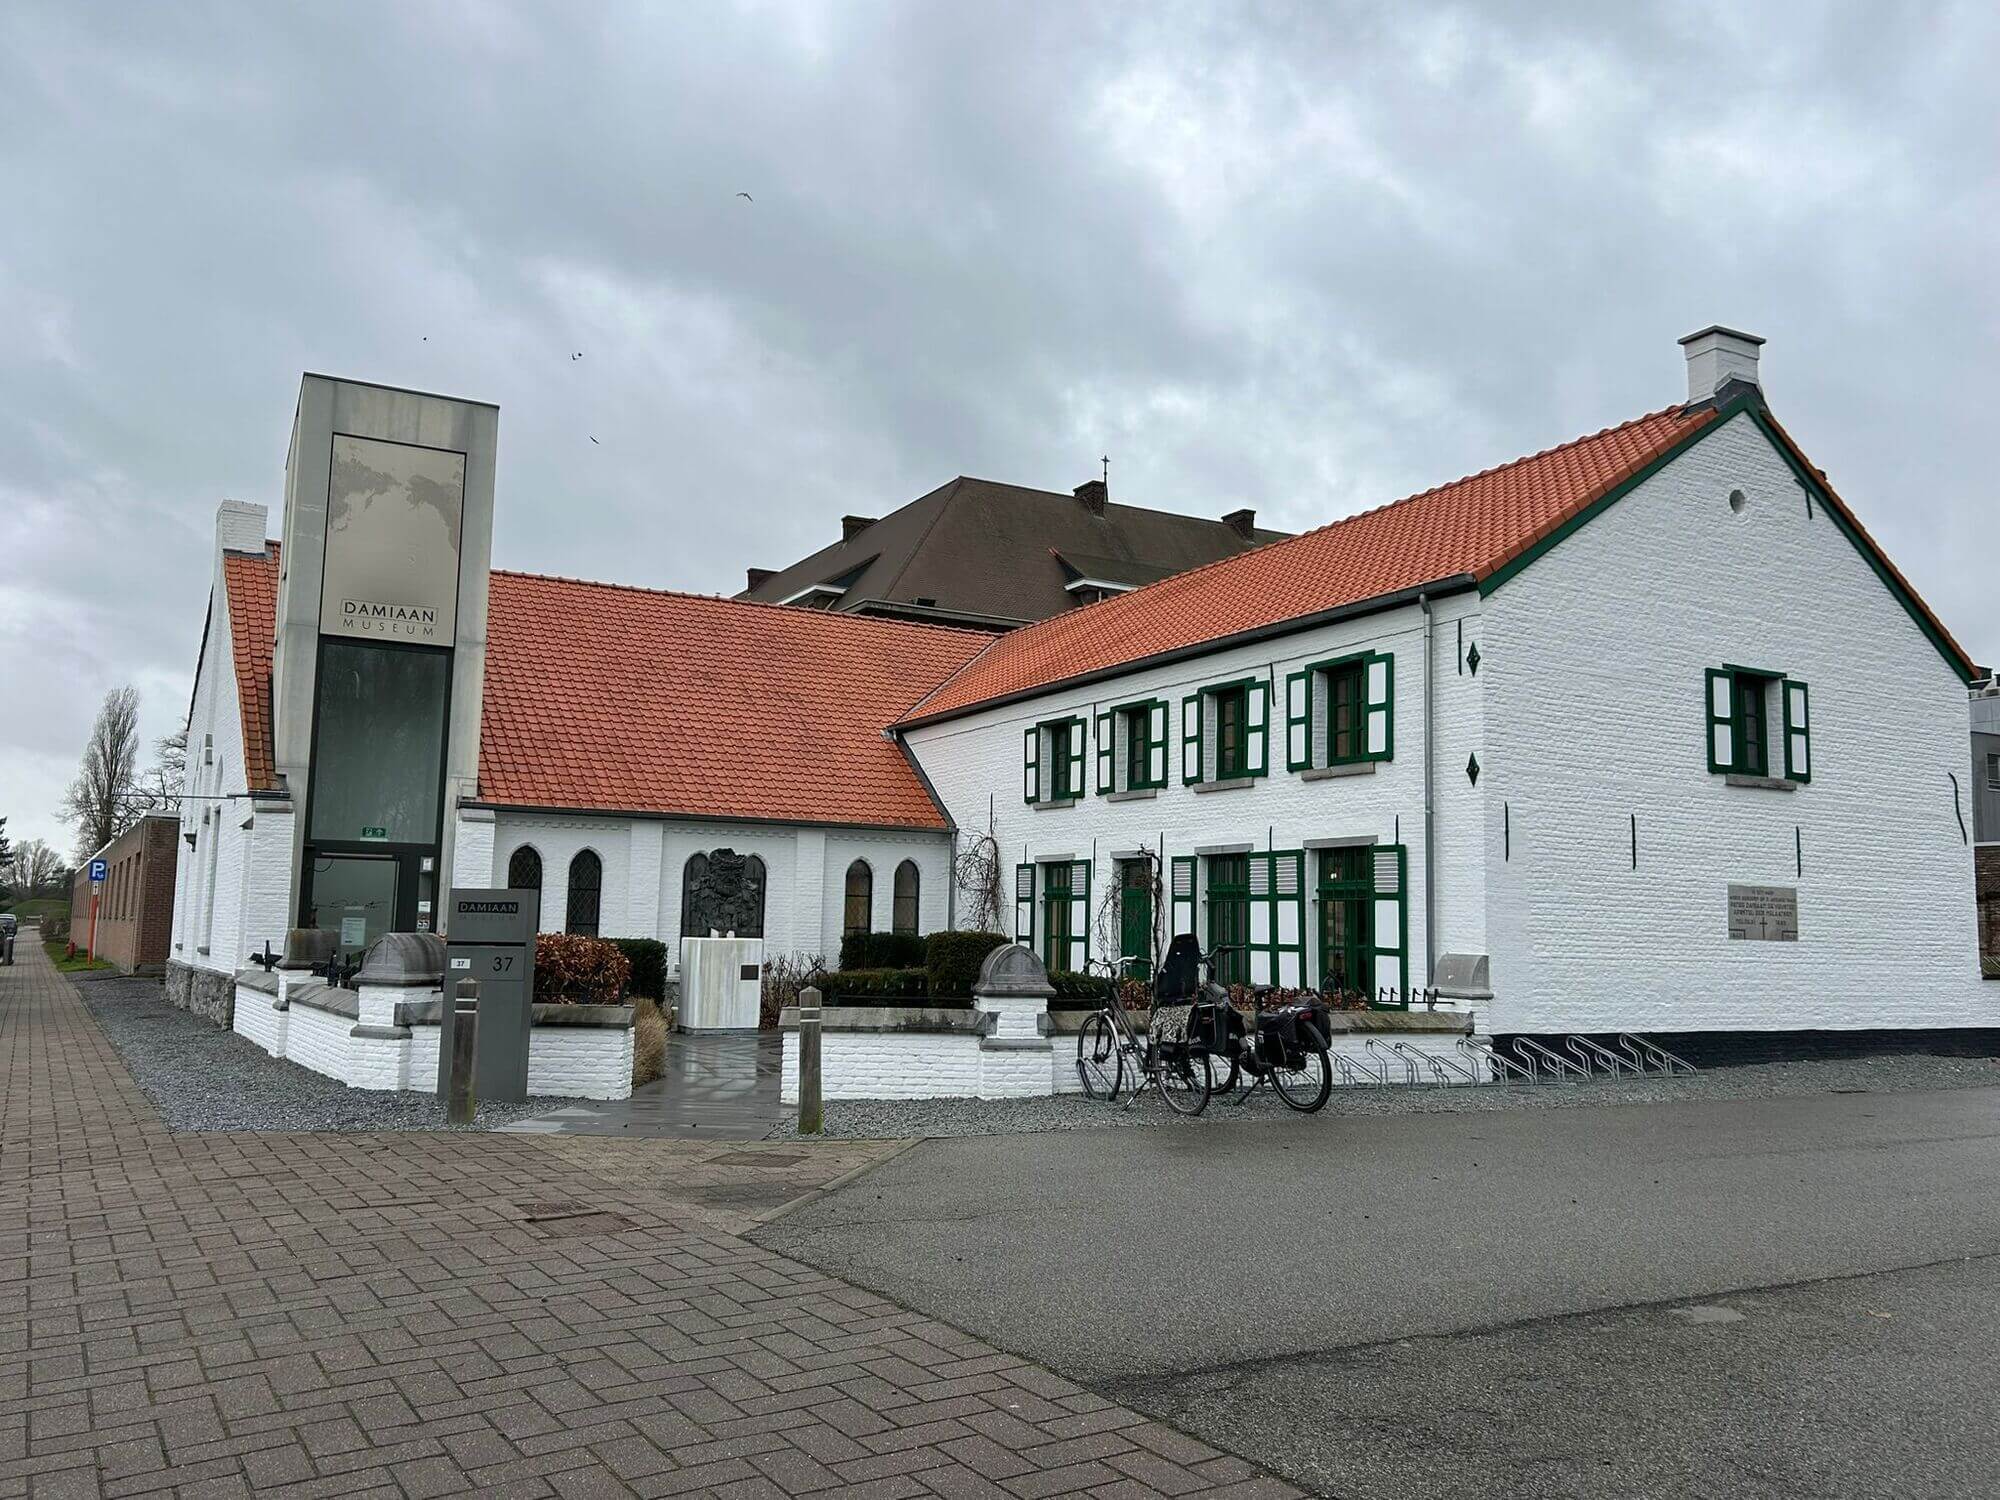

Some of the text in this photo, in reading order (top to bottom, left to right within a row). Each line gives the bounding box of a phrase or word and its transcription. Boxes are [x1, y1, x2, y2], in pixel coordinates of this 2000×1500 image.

[344, 602, 434, 622] DAMIAAN
[342, 618, 434, 636] MUSEUM
[92, 862, 105, 877] P
[460, 902, 517, 912] DAMIAAN
[492, 956, 514, 972] 37
